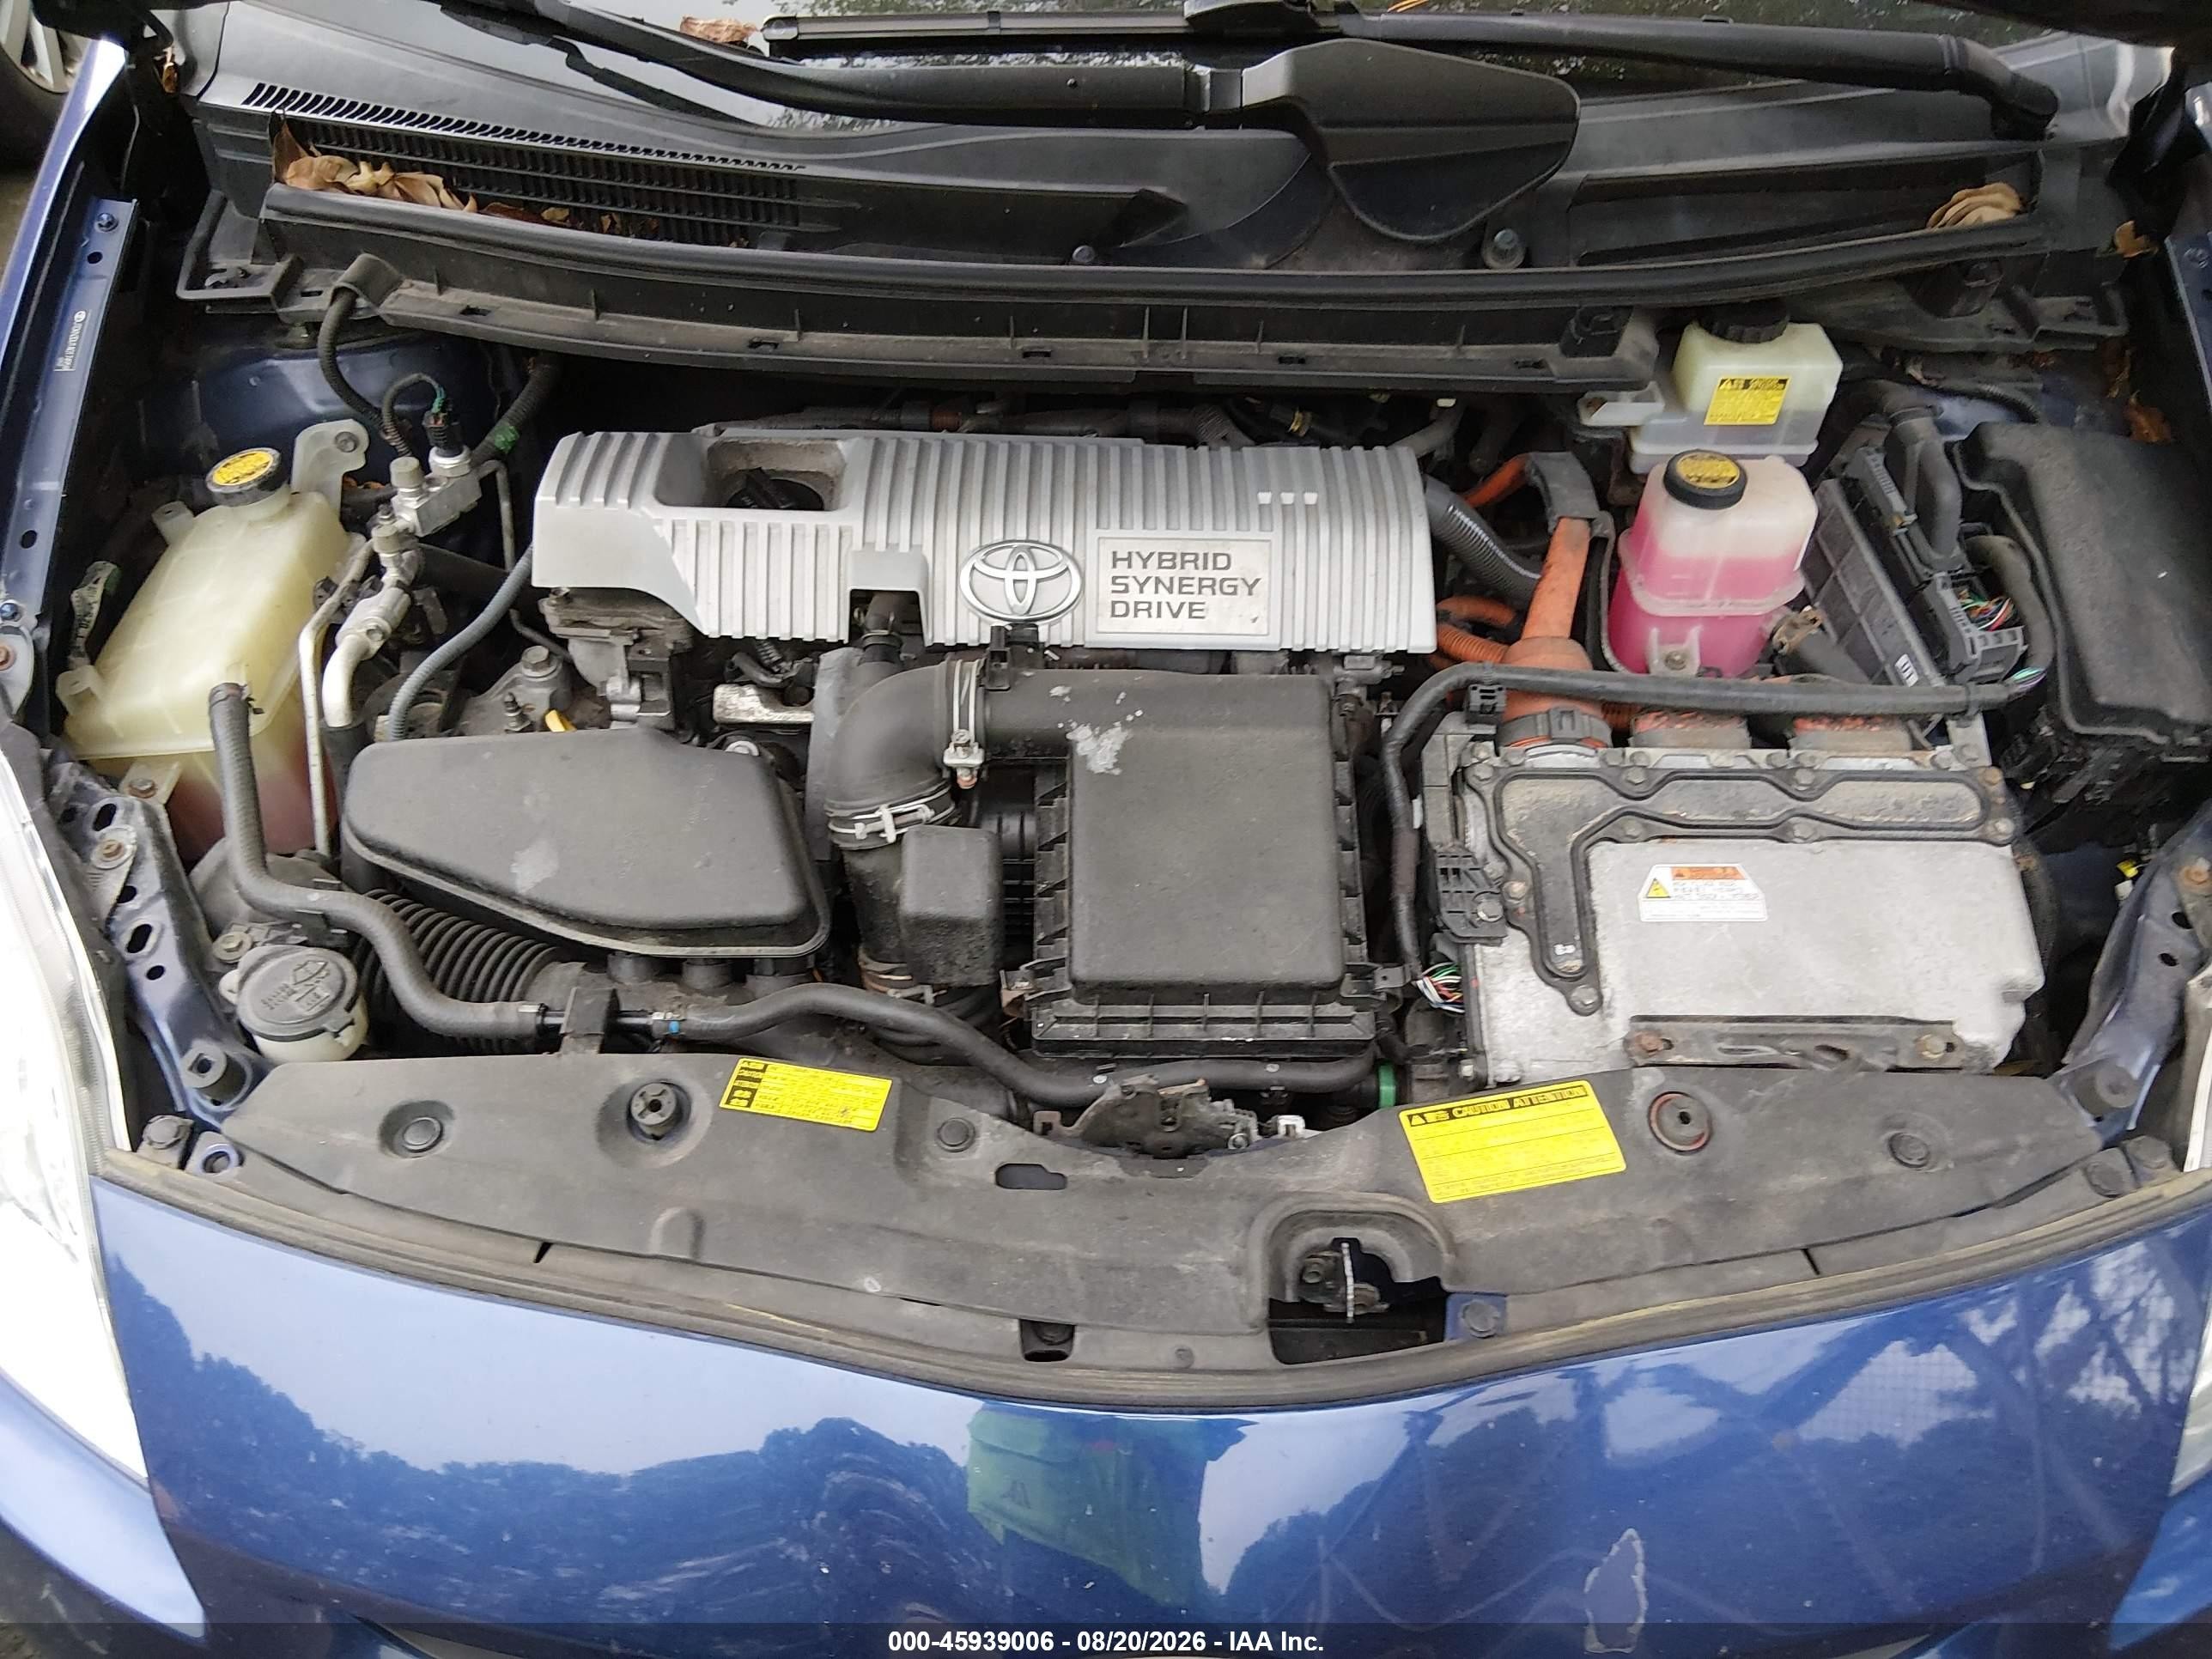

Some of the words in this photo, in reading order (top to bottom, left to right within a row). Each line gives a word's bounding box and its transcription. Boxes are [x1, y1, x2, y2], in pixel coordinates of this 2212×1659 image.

[1111, 550, 1232, 571] HYBRID
[1110, 575, 1261, 596] SYNERGY
[1110, 599, 1206, 620] DRIVE
